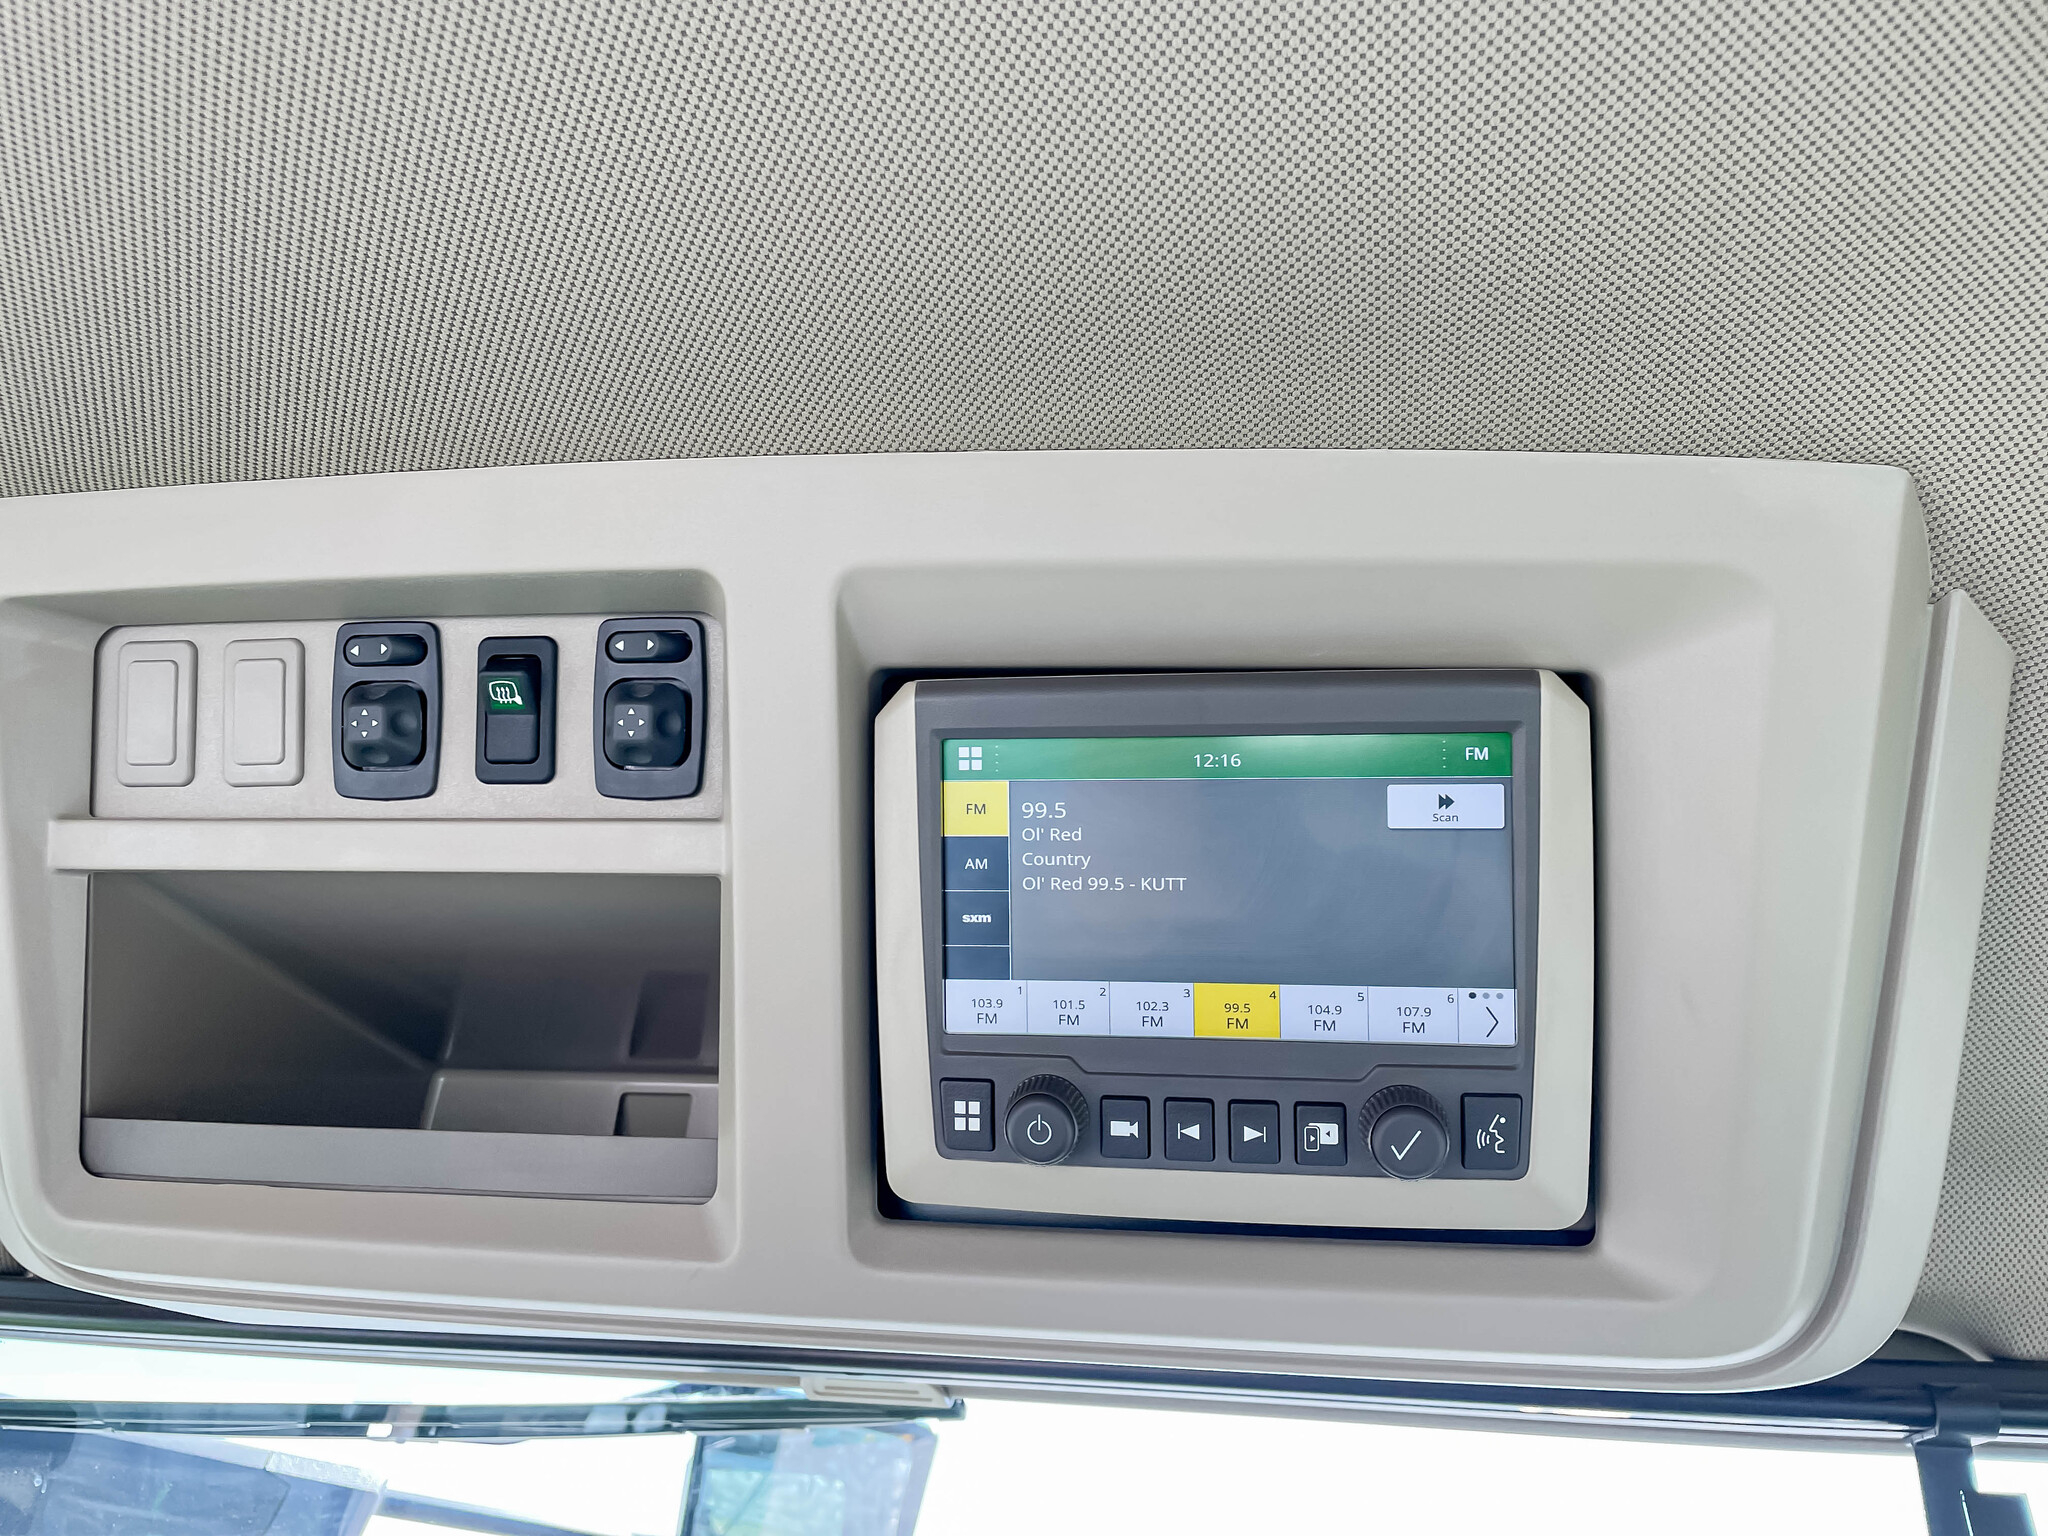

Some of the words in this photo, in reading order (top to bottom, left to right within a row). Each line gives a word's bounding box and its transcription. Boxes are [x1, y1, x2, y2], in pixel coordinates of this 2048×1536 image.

[1465, 746, 1489, 761] FM
[1193, 753, 1242, 769] 12:16
[966, 803, 986, 815] FM
[1021, 802, 1067, 819] 99.5
[1432, 813, 1459, 822] Scan
[1050, 827, 1082, 842] Red
[964, 858, 988, 870] AM
[1021, 852, 1092, 870] Country
[1050, 876, 1083, 891] Red
[1087, 877, 1125, 891] 99.5
[1141, 877, 1188, 891] KUTT
[961, 914, 992, 923] sxm
[1017, 986, 1023, 996] 1
[1099, 987, 1107, 997] 2
[1183, 988, 1191, 998] 3
[1268, 990, 1277, 1000] 4
[1357, 991, 1365, 1002] 5
[971, 998, 1003, 1009] 103.9
[1053, 999, 1086, 1010] 101.5
[1447, 993, 1455, 1004] 6
[1136, 1001, 1169, 1012] 102.3
[1224, 1002, 1251, 1014] 99.5
[1307, 1004, 1342, 1016] 104.9
[1396, 1006, 1432, 1018] 107.9
[977, 1012, 998, 1025] FM
[1058, 1014, 1080, 1026] FM
[1142, 1015, 1163, 1028] FM
[1227, 1017, 1249, 1030] FM
[1314, 1019, 1336, 1032] FM
[1402, 1021, 1425, 1034] FM
